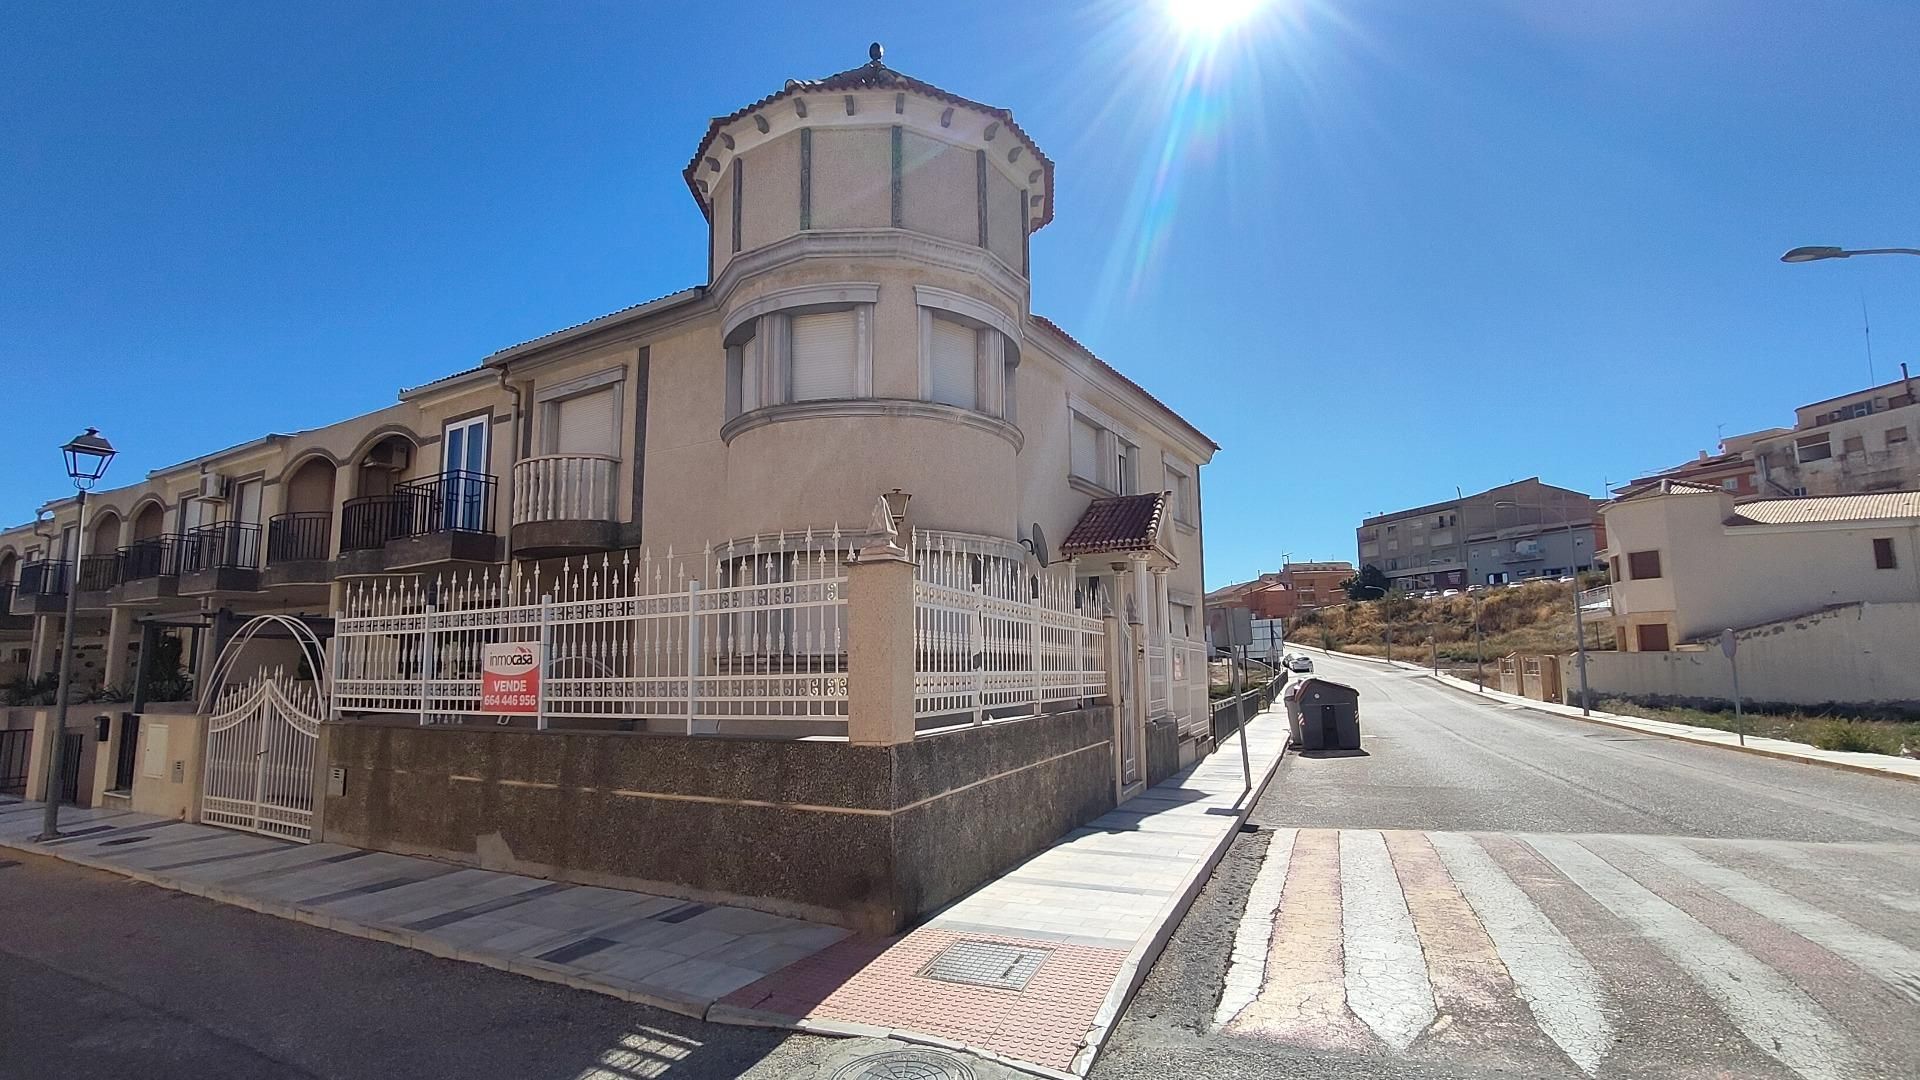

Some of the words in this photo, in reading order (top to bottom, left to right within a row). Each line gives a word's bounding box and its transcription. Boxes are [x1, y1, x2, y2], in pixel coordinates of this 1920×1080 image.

[489, 652, 533, 666] inmocasa
[493, 680, 527, 692] VENDE
[484, 695, 500, 706] 664
[501, 695, 518, 706] 446
[519, 694, 536, 706] 956
